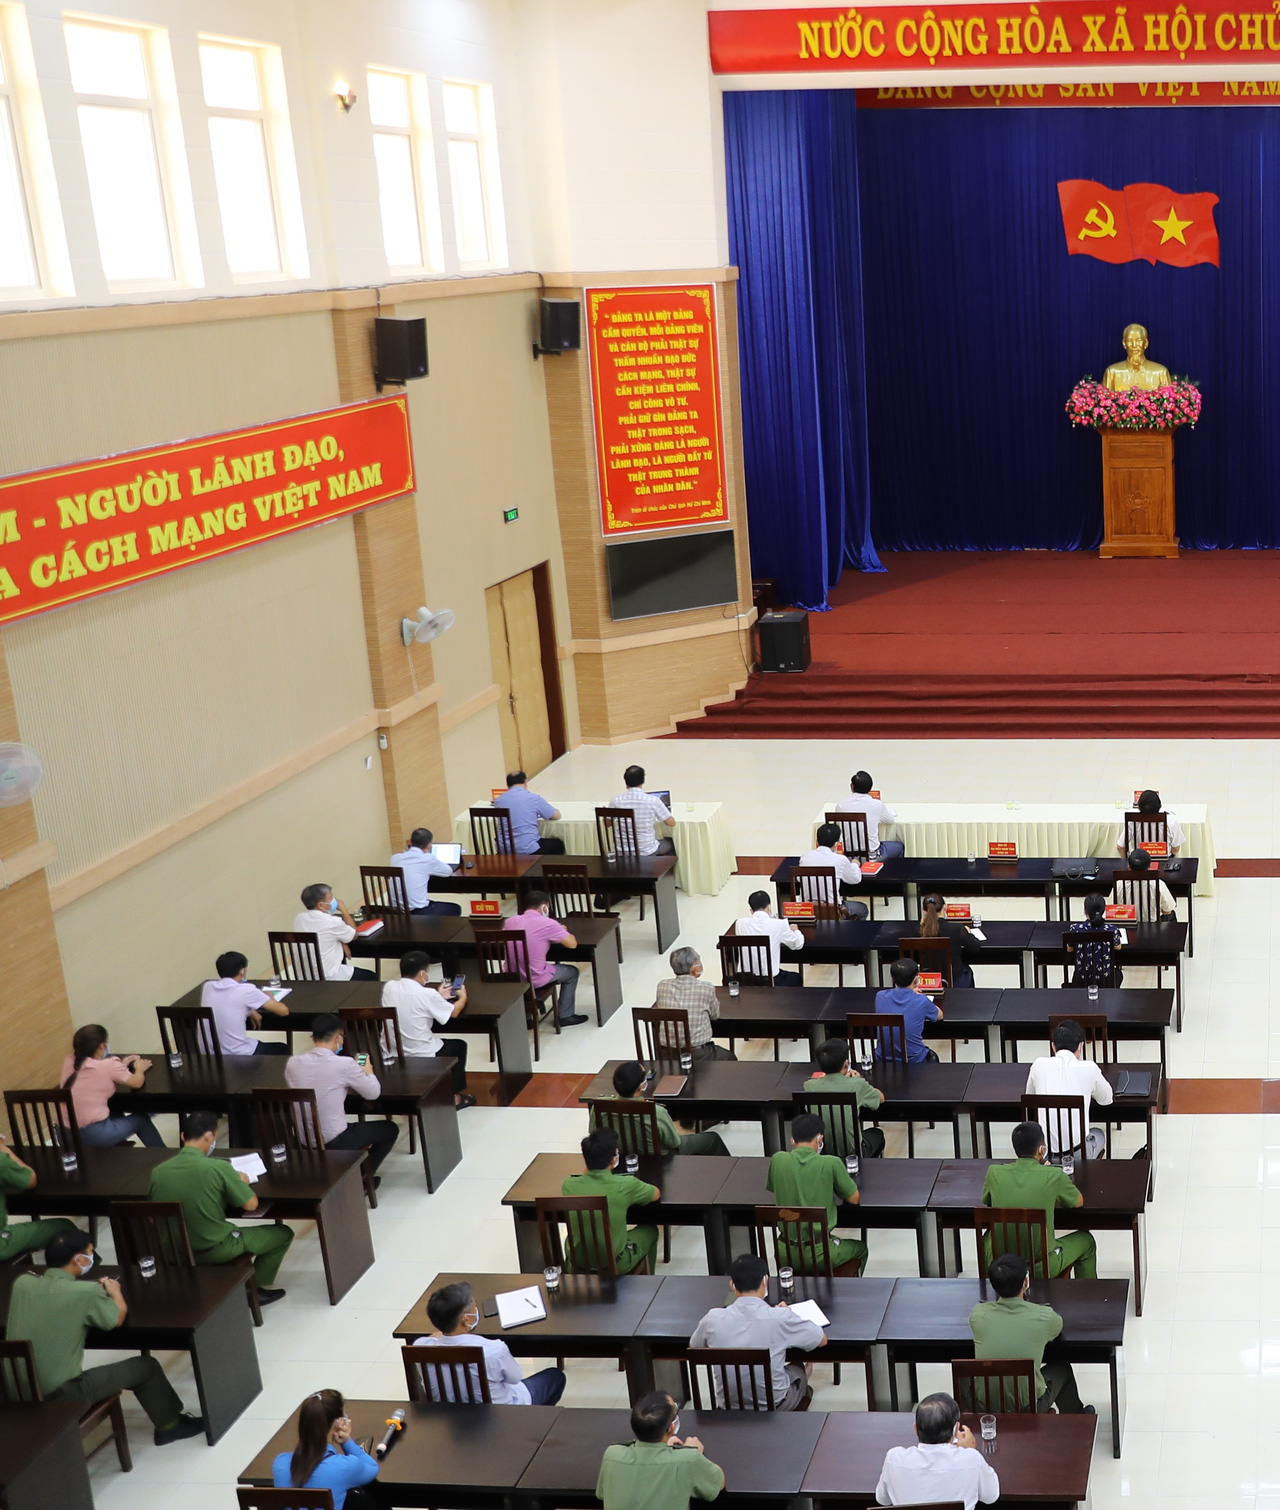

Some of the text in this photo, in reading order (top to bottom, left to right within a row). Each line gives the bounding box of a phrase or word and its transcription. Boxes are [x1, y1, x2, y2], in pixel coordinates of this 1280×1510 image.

[797, 8, 885, 58] NƯỚC
[895, 9, 988, 65] CỘNG
[996, 4, 1072, 54] HÒA
[1082, 6, 1134, 52] XÃ
[1144, 4, 1206, 60] HỘI
[30, 532, 140, 588] CÁCH
[147, 502, 247, 555] MẠNG
[252, 480, 321, 522] VIỆT
[327, 462, 383, 501] NAM
[56, 469, 182, 529] NGƯỜI
[188, 450, 276, 496] LÃNH
[281, 435, 345, 472] ĐẠO,
